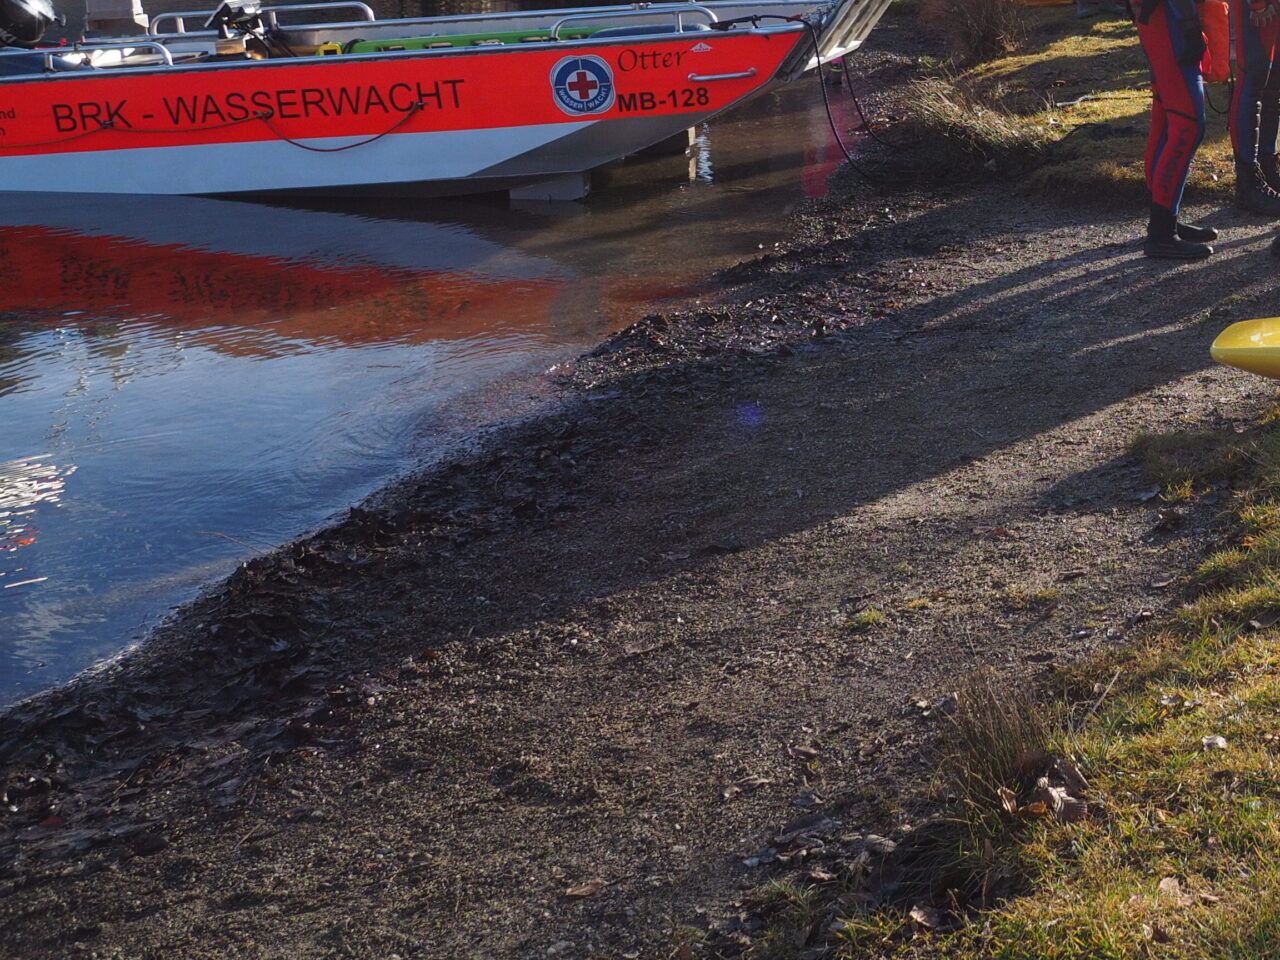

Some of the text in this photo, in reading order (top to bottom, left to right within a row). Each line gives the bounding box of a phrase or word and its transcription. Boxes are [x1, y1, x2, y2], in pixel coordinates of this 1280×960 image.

[617, 49, 688, 72] Otter
[52, 100, 132, 133] BRK
[163, 79, 465, 125] WASSERWACHT
[559, 87, 608, 109] WASSER WACHT
[617, 87, 710, 112] MB-128
